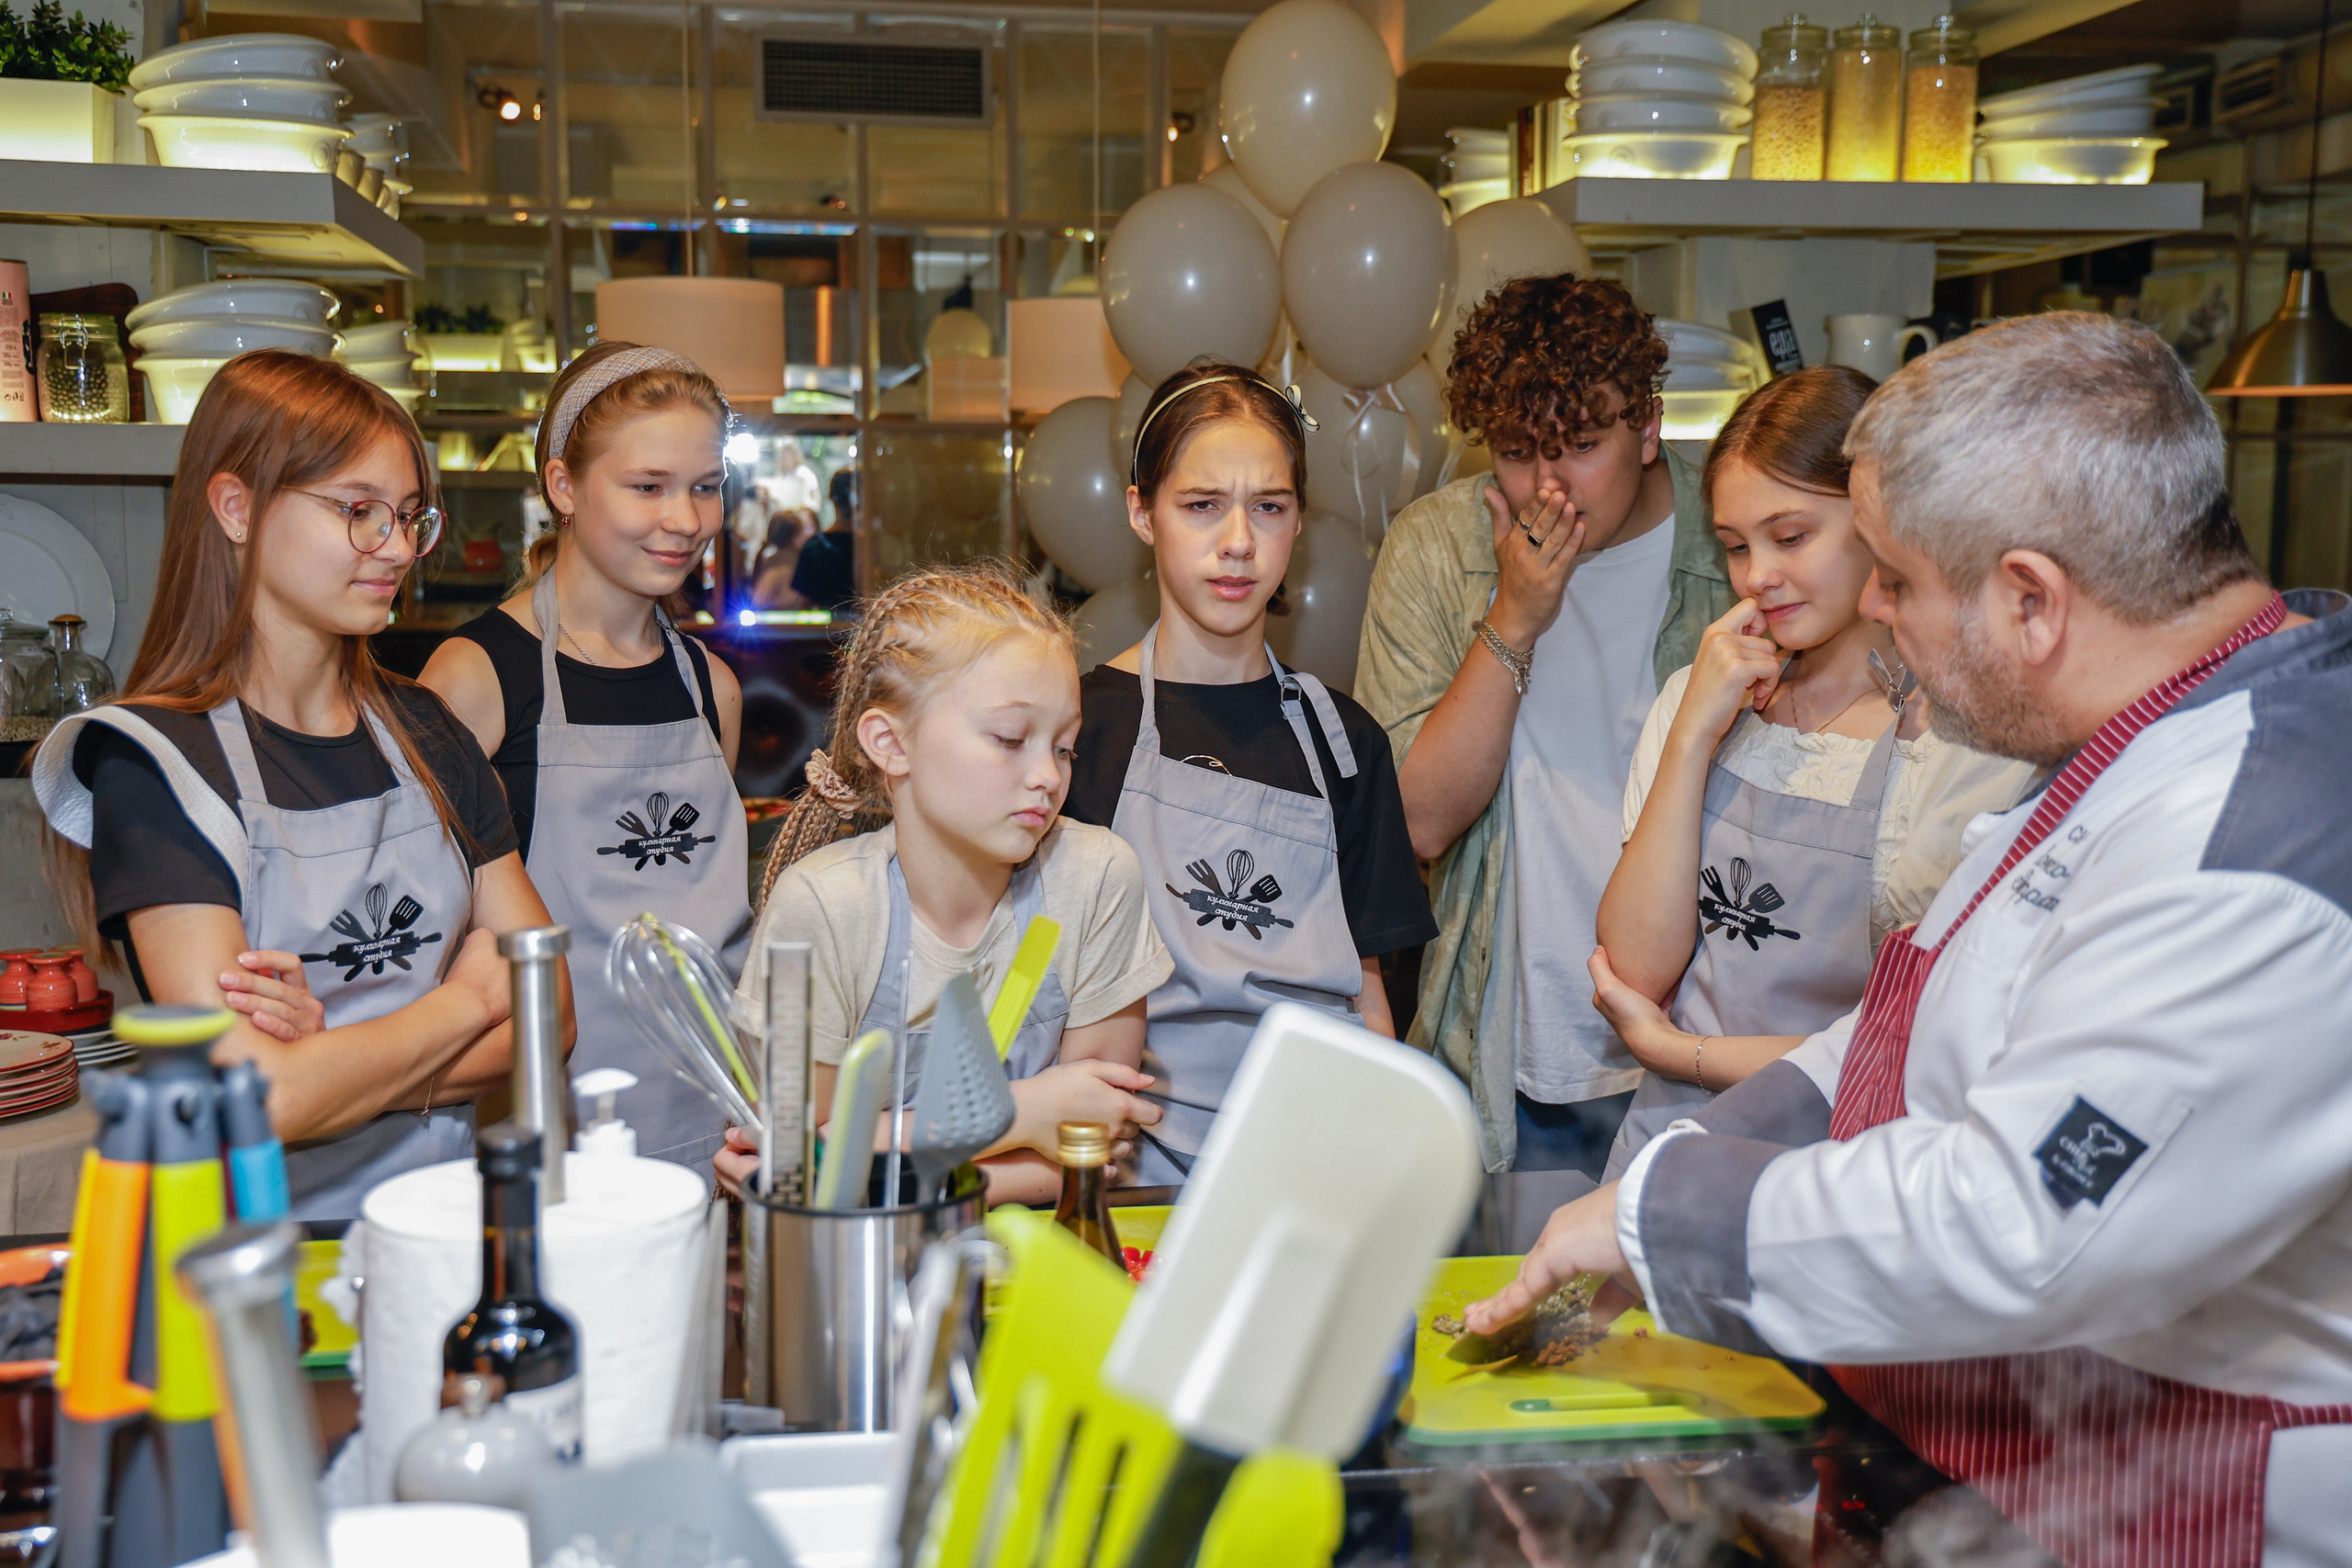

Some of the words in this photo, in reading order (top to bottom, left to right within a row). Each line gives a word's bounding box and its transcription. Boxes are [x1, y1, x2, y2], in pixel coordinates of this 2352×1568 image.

[638, 835, 682, 848] кулинарная
[646, 845, 674, 857] студия
[1206, 895, 1260, 913] кулинарная
[1215, 907, 1249, 921] студия
[1713, 903, 1757, 923] кулинарная
[1721, 917, 1747, 931] студия
[353, 936, 401, 953] кулинарная
[363, 950, 393, 964] студия
